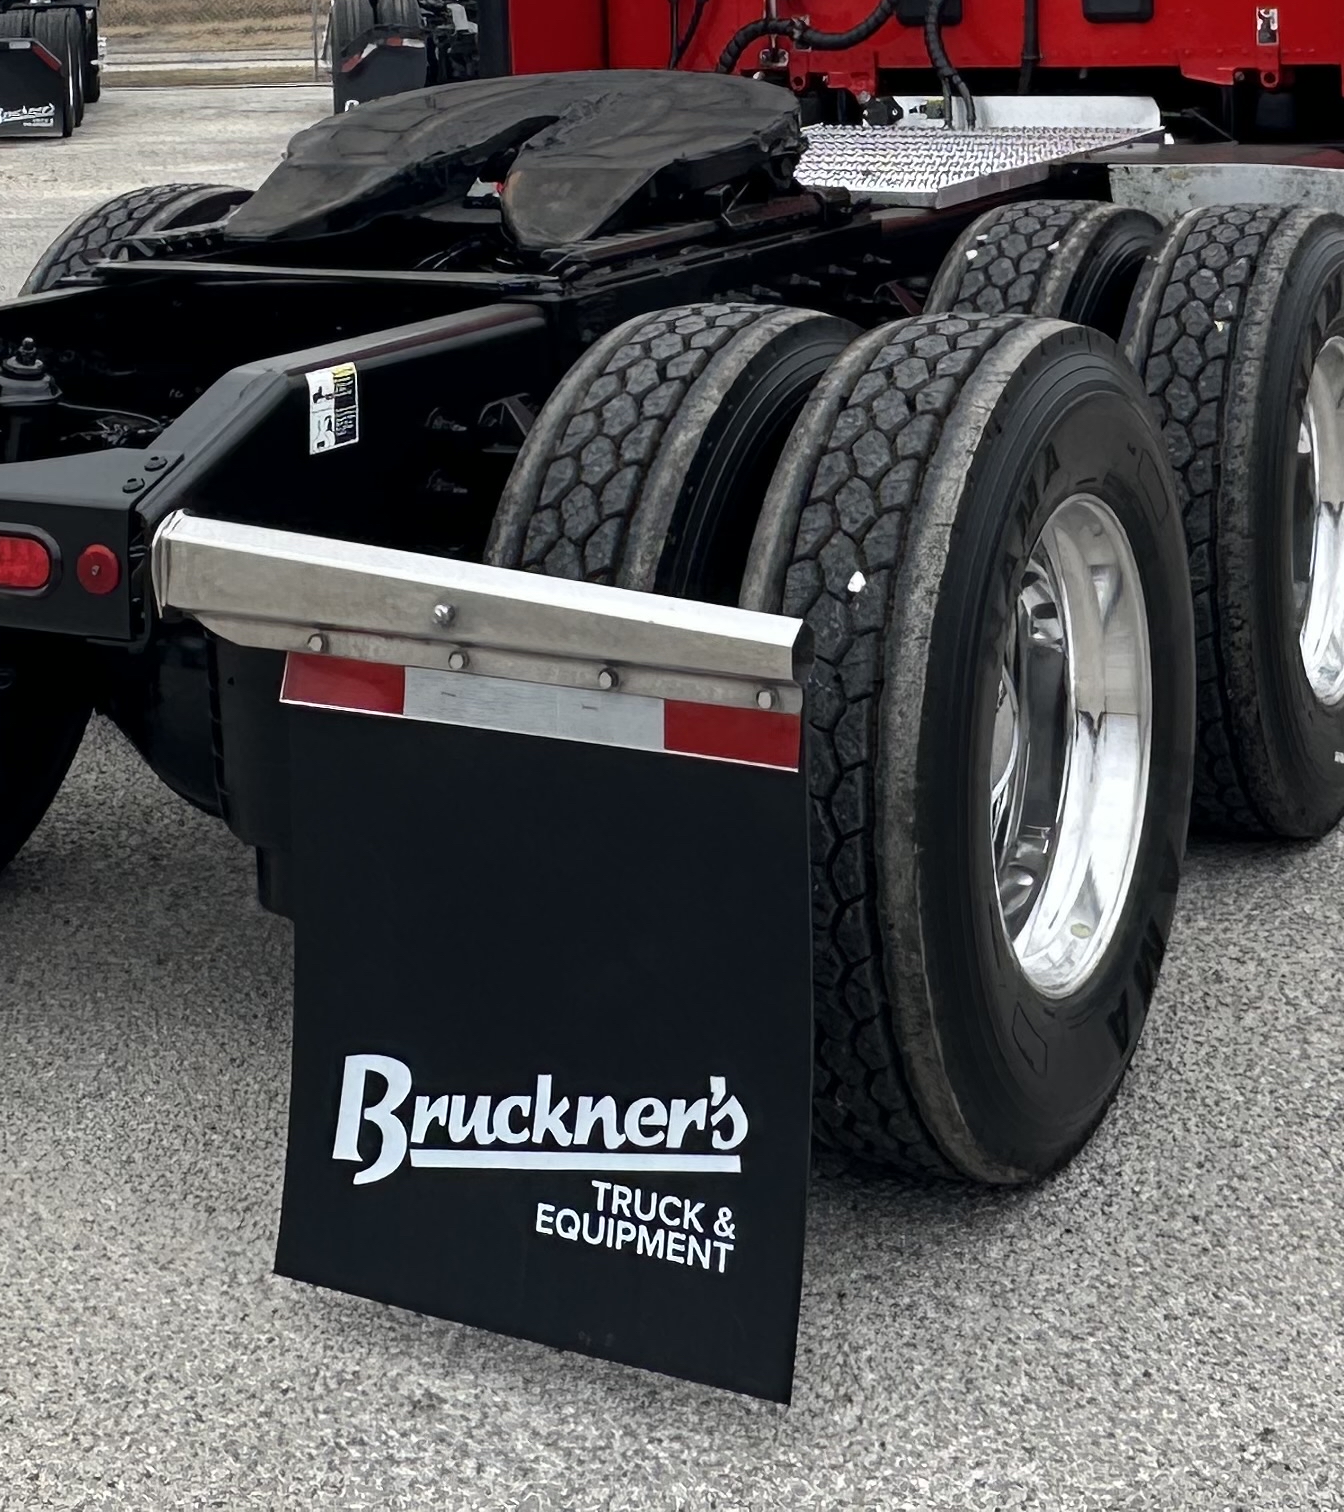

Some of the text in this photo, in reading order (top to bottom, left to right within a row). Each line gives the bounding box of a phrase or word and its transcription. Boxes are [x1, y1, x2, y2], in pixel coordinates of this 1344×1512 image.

[332, 1054, 749, 1185] Bruckner's
[535, 1202, 735, 1273] EQUIPMENT
[591, 1179, 736, 1240] TRUCK &
